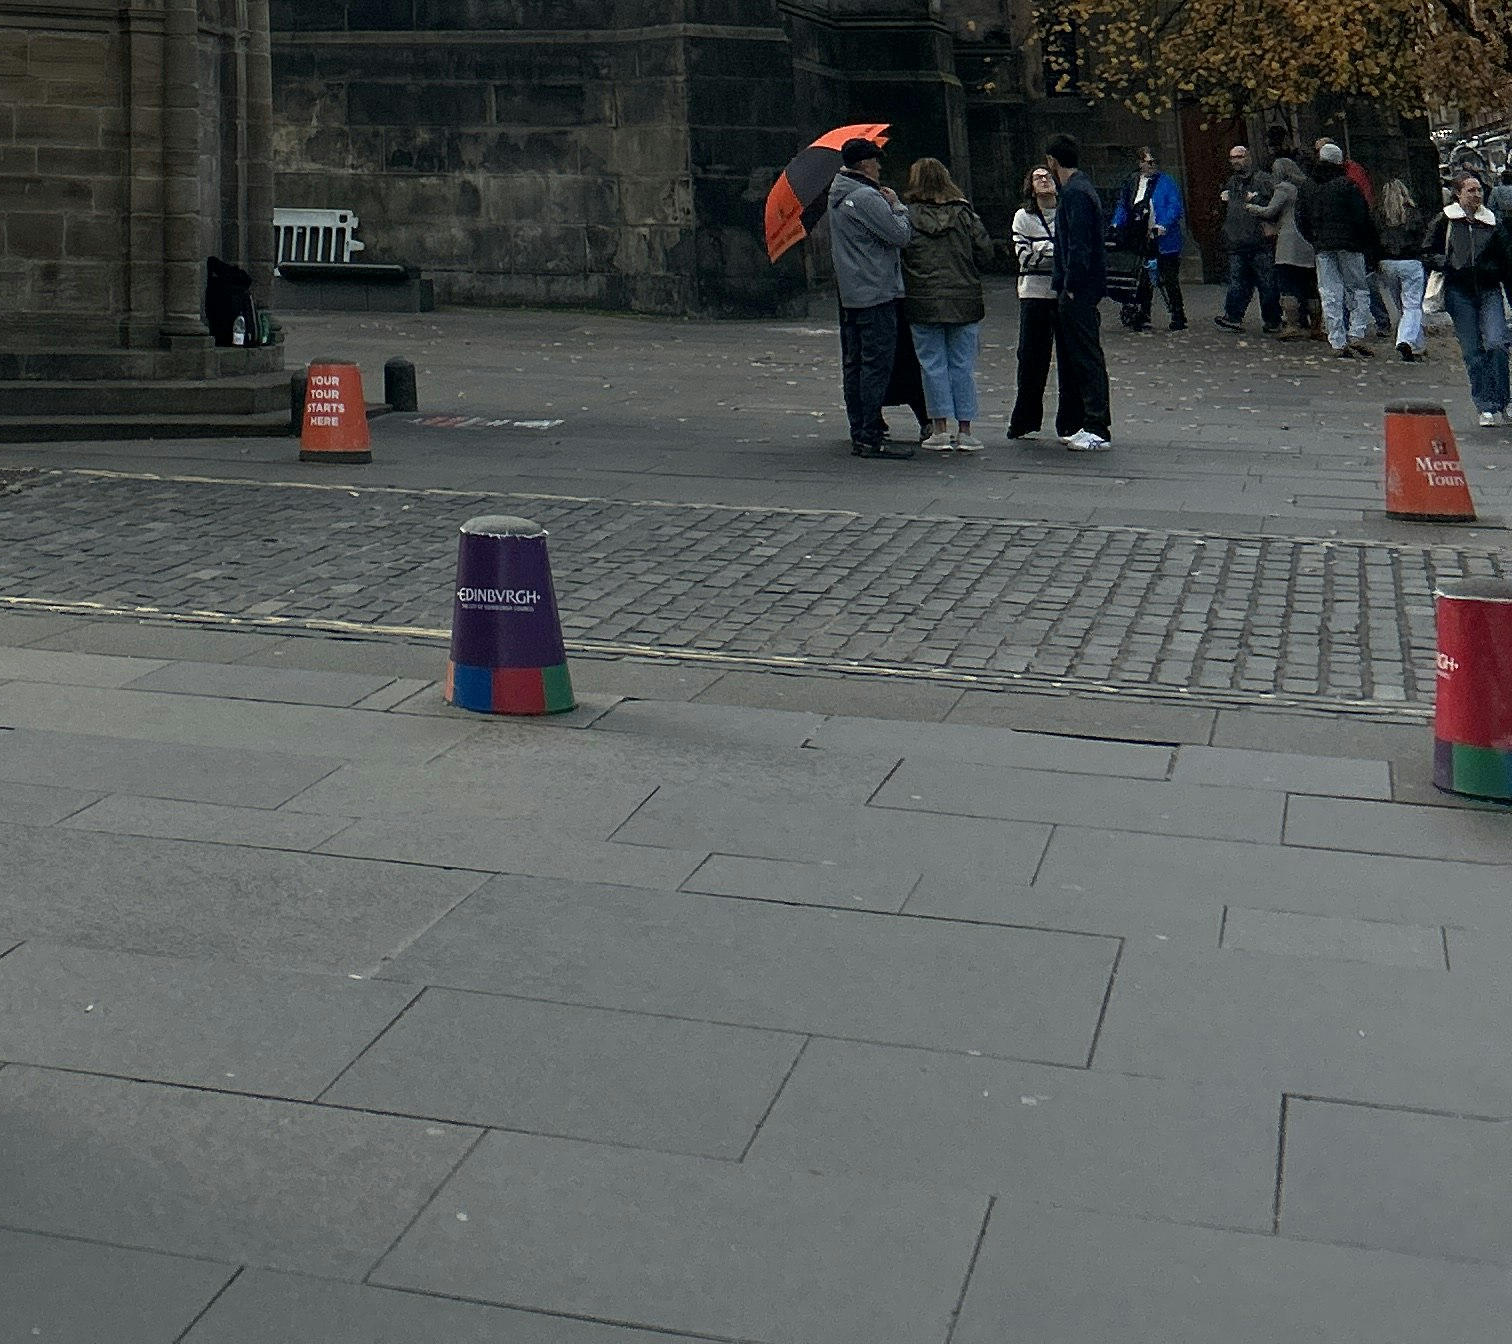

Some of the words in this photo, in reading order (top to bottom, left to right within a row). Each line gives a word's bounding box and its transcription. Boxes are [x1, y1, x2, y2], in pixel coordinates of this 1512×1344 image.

[311, 375, 340, 386] YOUR
[311, 389, 340, 400] TOUR
[307, 402, 345, 413] STARTS
[310, 416, 339, 427] HERE
